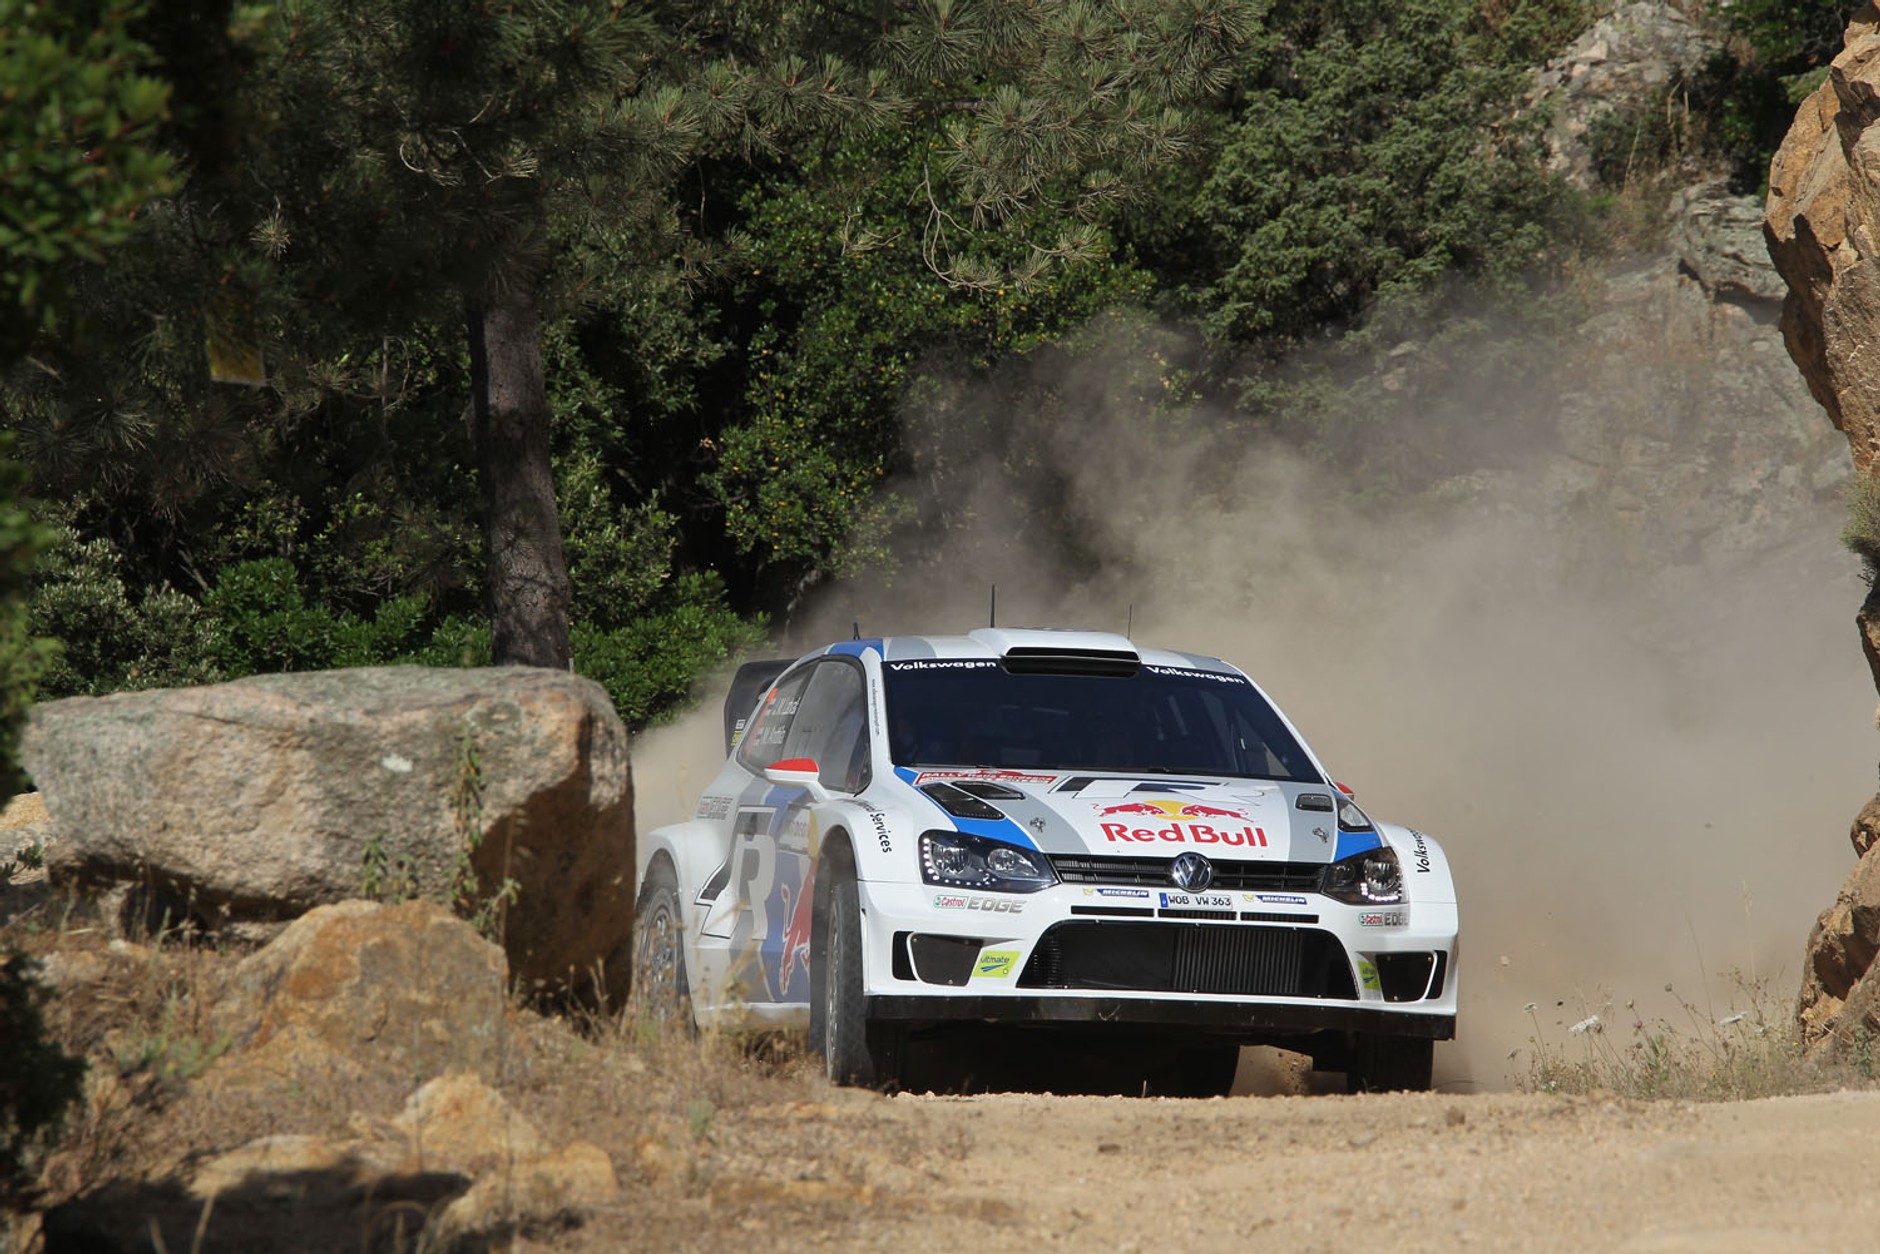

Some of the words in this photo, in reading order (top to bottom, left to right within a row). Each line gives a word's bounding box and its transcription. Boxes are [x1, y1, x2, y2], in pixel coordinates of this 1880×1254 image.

[890, 661, 997, 671] Volkswagen
[1145, 666, 1245, 684] Volkswagen
[870, 812, 892, 853] Services
[1100, 823, 1185, 842] Red
[1188, 824, 1268, 847] Bull
[1103, 889, 1149, 897] MICHELIN
[1168, 895, 1190, 905] WOB
[1195, 896, 1209, 905] VW
[1211, 897, 1231, 906] 363
[941, 896, 966, 907] Castrol
[967, 896, 1027, 914] EDGE
